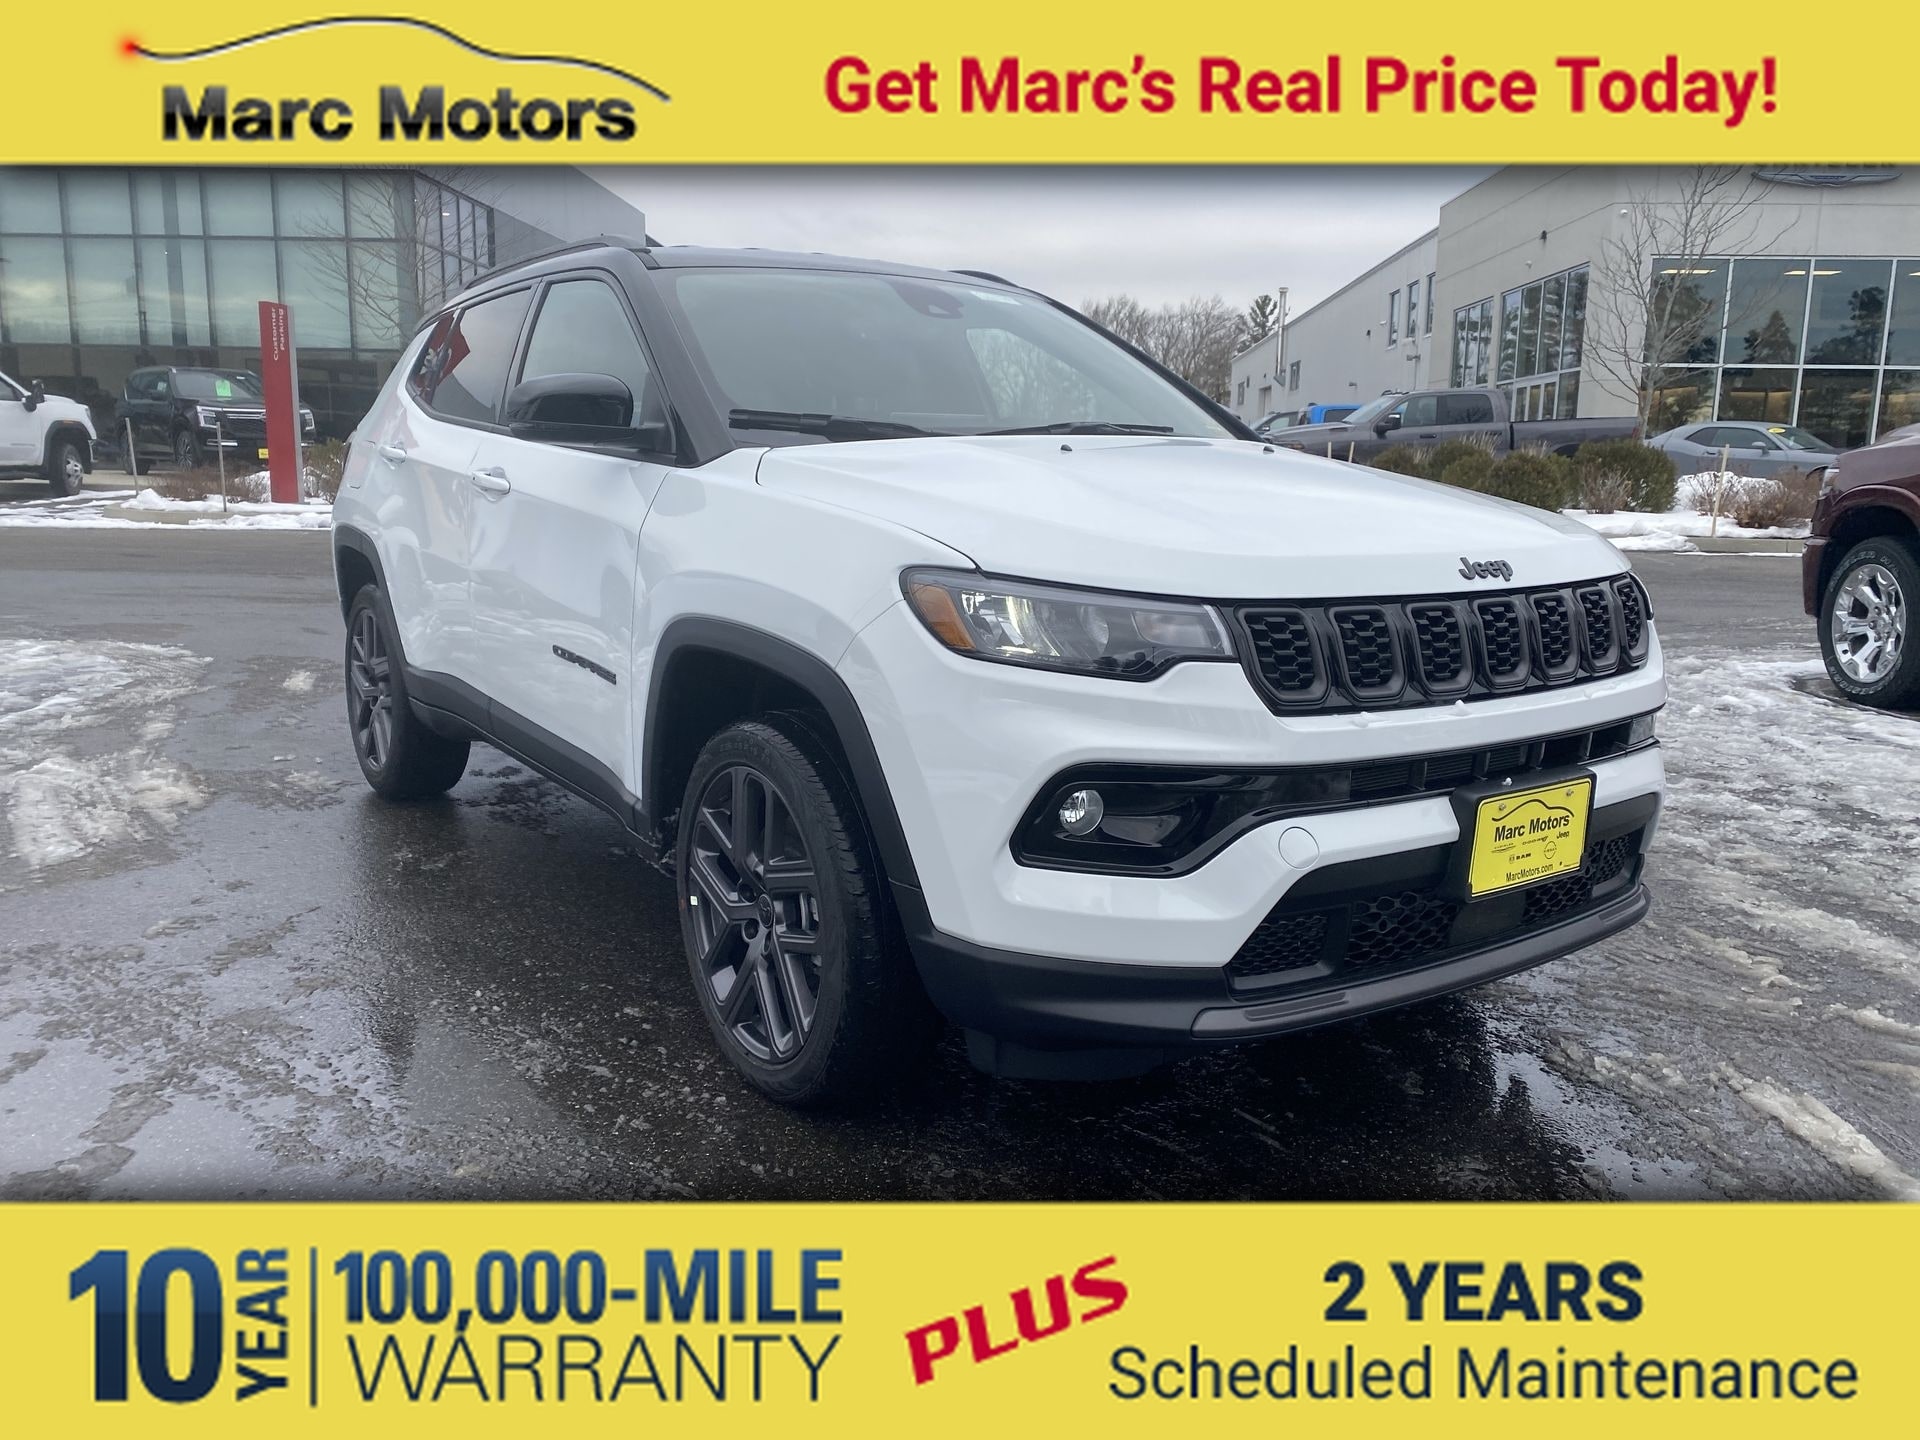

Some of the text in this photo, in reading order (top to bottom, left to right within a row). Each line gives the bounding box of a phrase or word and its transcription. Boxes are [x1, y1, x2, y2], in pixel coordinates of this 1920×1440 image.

[1458, 556, 1514, 582] Jeep
[1494, 814, 1570, 842] Marc Motors
[1556, 830, 1570, 839] Jeep
[1506, 864, 1554, 881] MarcMotors.com
